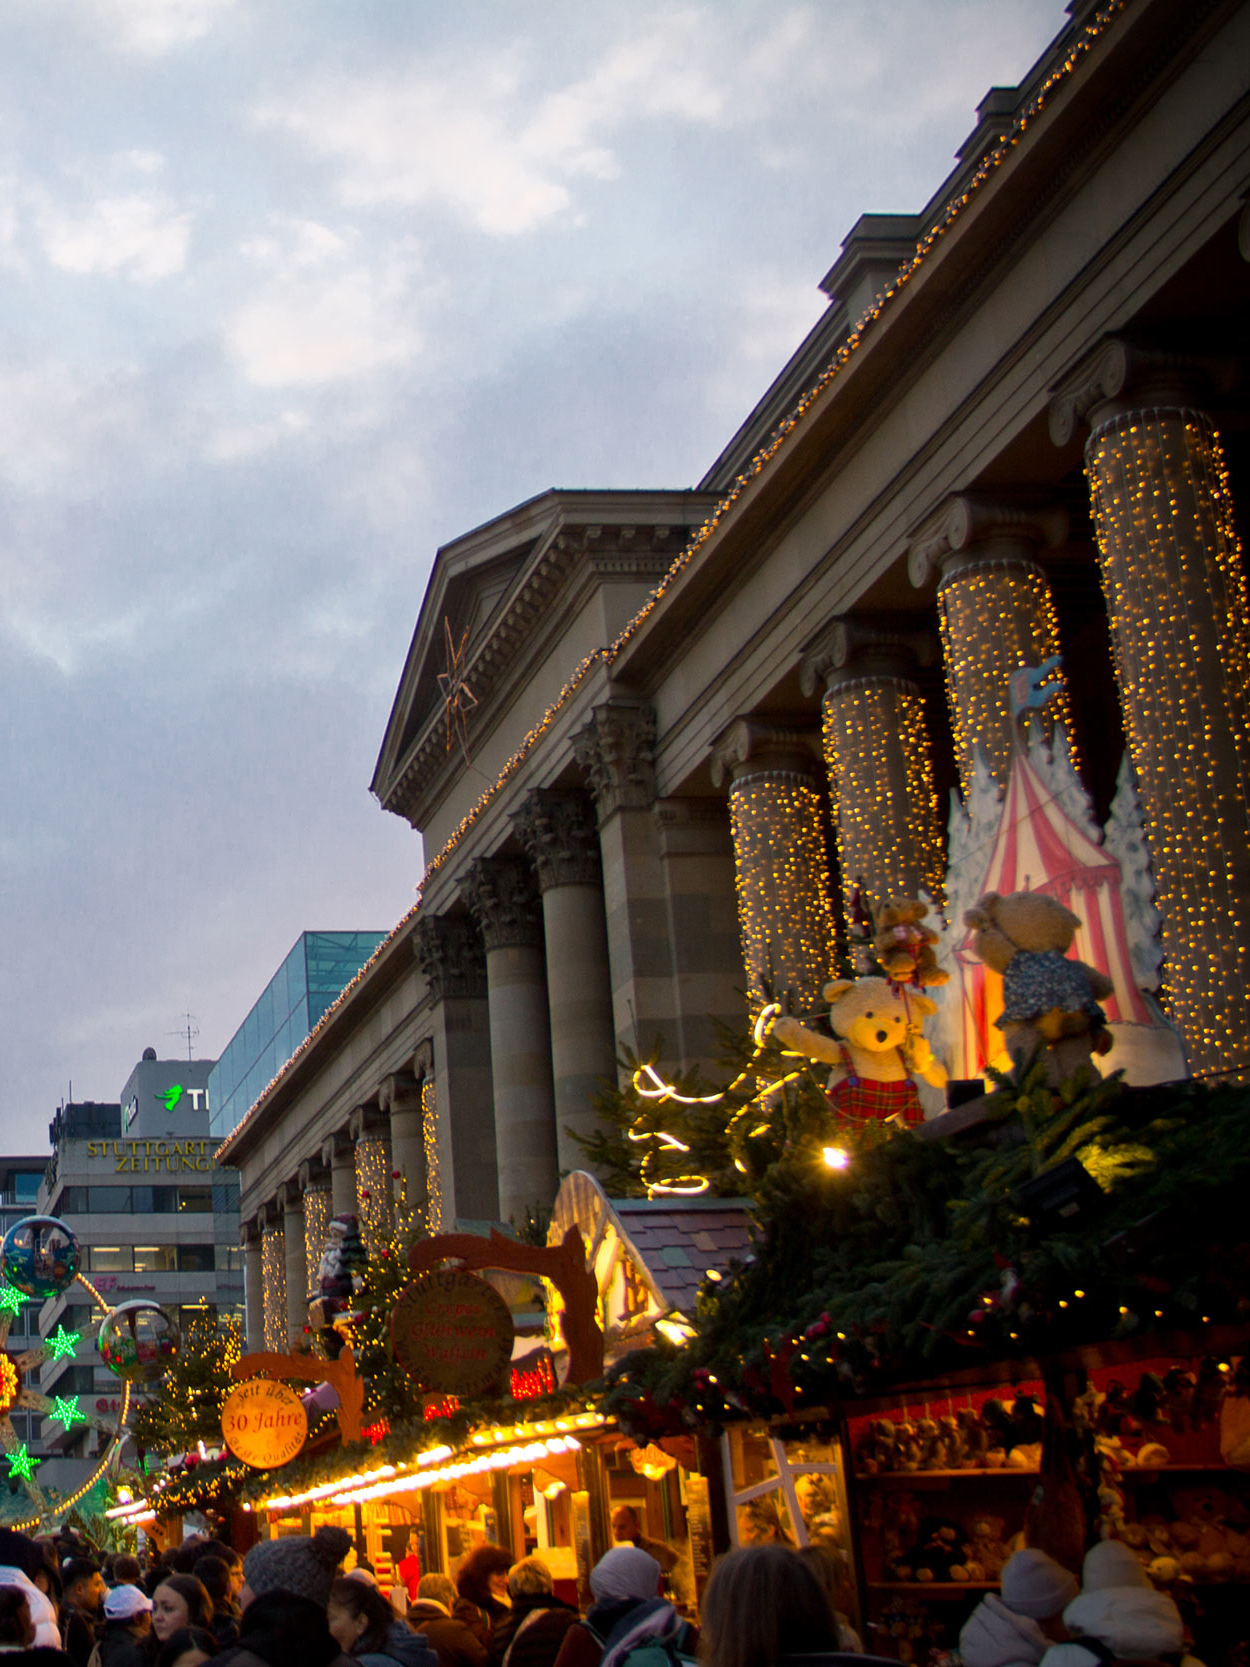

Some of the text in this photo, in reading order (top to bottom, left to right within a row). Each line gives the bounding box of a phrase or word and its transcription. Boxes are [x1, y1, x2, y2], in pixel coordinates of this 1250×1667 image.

[87, 1141, 218, 1157] STUTTGART
[225, 1407, 303, 1434] 30 Jahre
